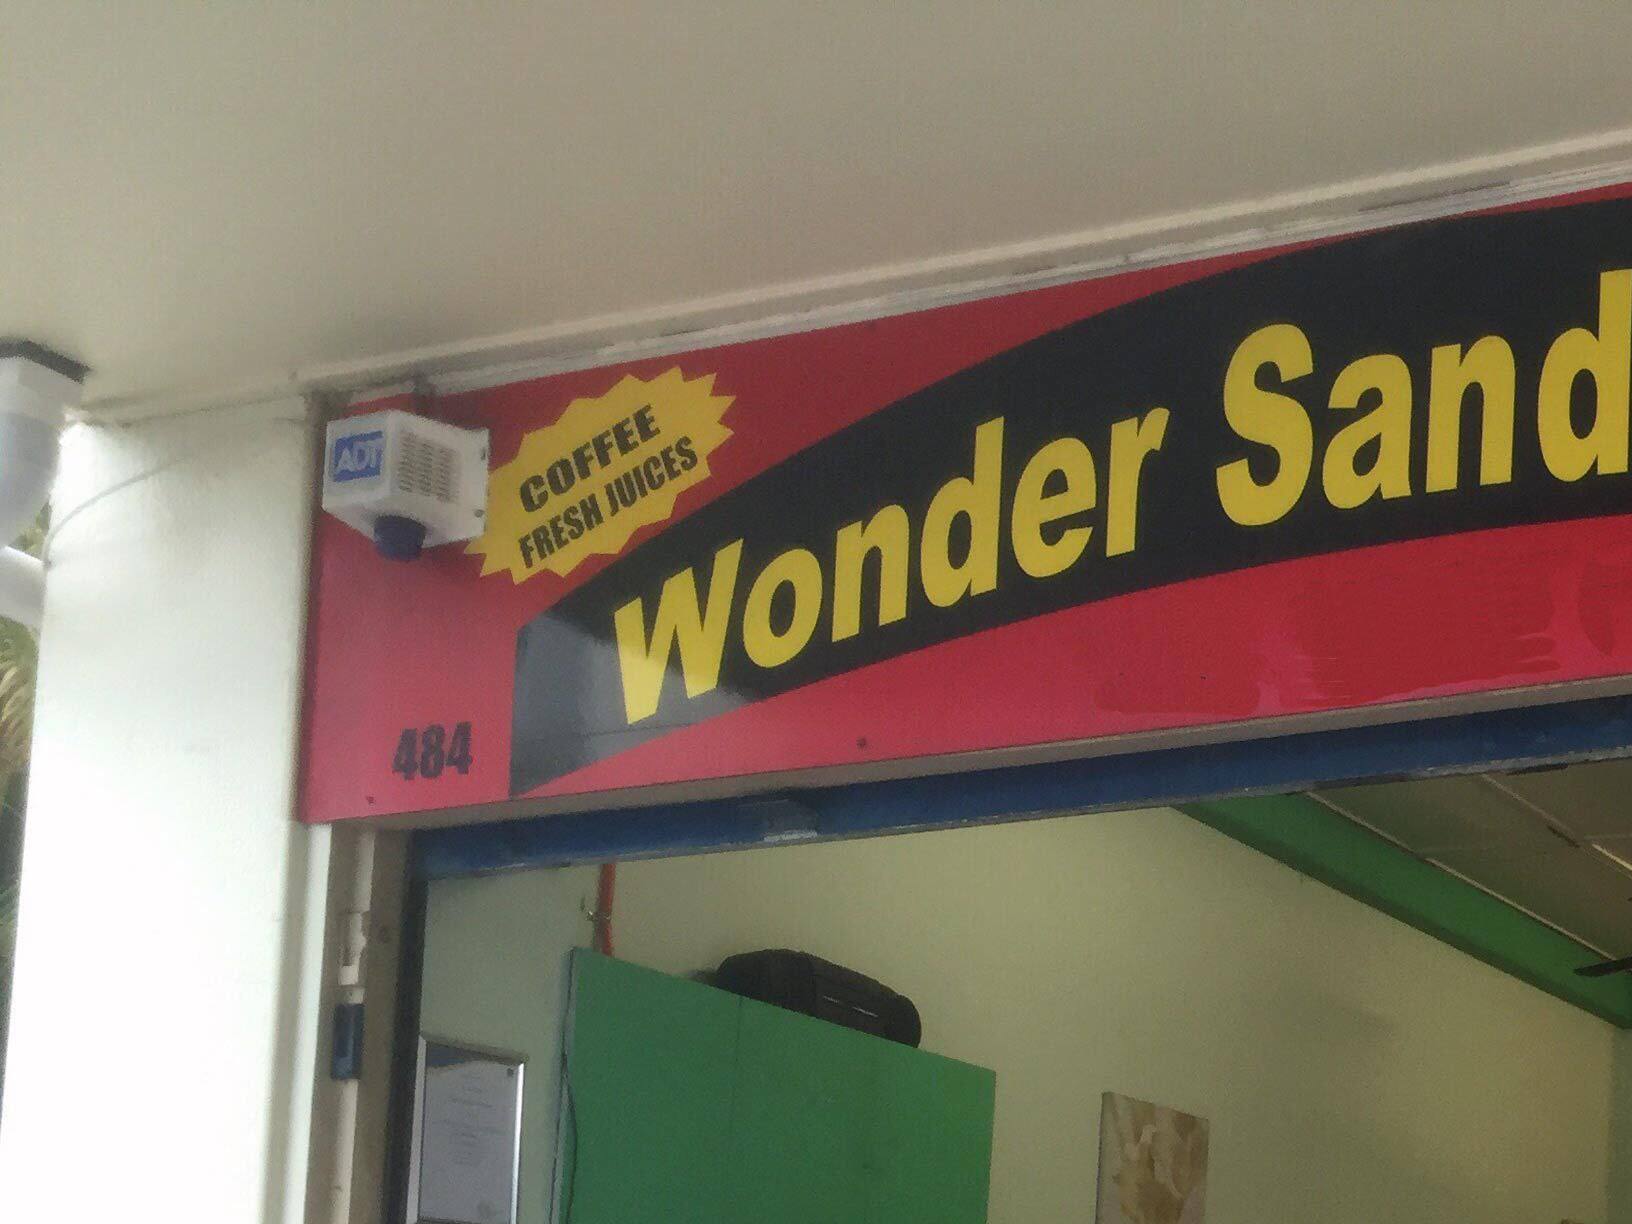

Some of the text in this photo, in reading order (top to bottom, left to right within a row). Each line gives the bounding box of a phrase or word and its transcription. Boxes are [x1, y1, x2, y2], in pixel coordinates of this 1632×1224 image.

[336, 440, 382, 471] ADT
[519, 404, 660, 513] COFFEE
[519, 436, 699, 569] FRESH JUICES
[614, 407, 1170, 725] Wonder
[392, 722, 473, 781] 484
